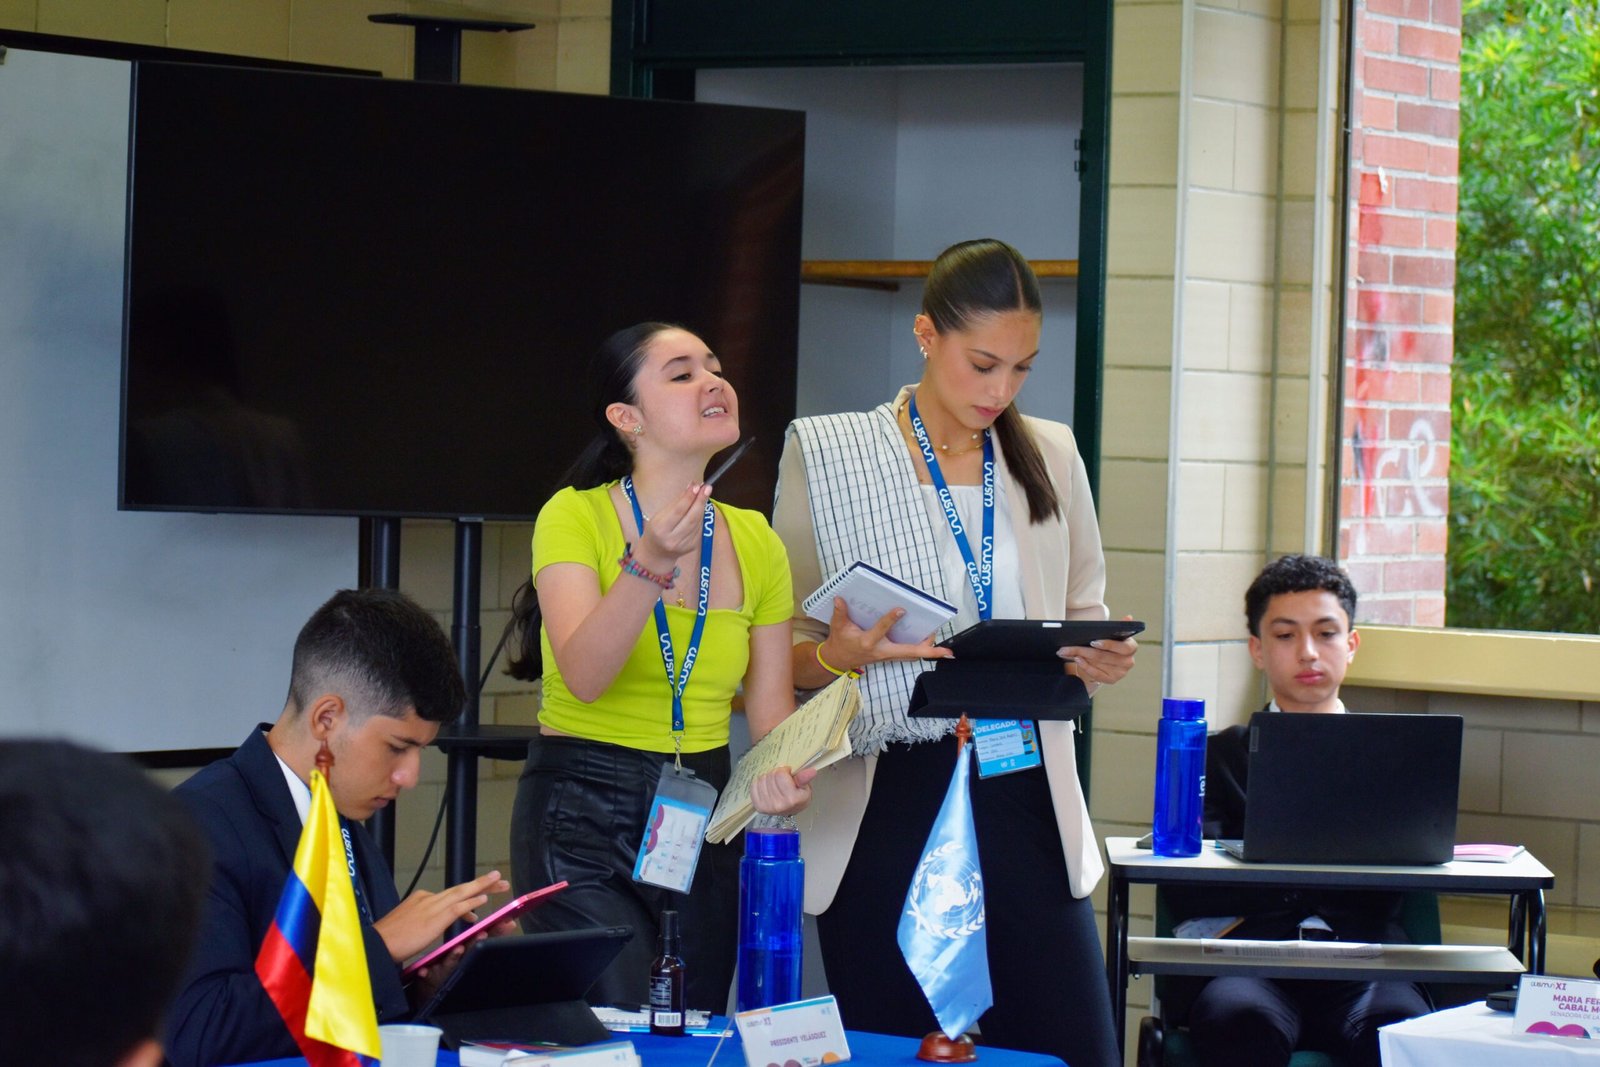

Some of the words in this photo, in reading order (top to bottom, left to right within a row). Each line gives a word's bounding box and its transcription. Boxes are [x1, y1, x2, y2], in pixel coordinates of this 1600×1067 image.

[975, 720, 1017, 733] DELEGADO
[1552, 994, 1583, 1004] MARIA
[1558, 1003, 1589, 1013] CABAL
[1591, 1006, 1600, 1014] M
[1550, 1011, 1582, 1019] SENADORA
